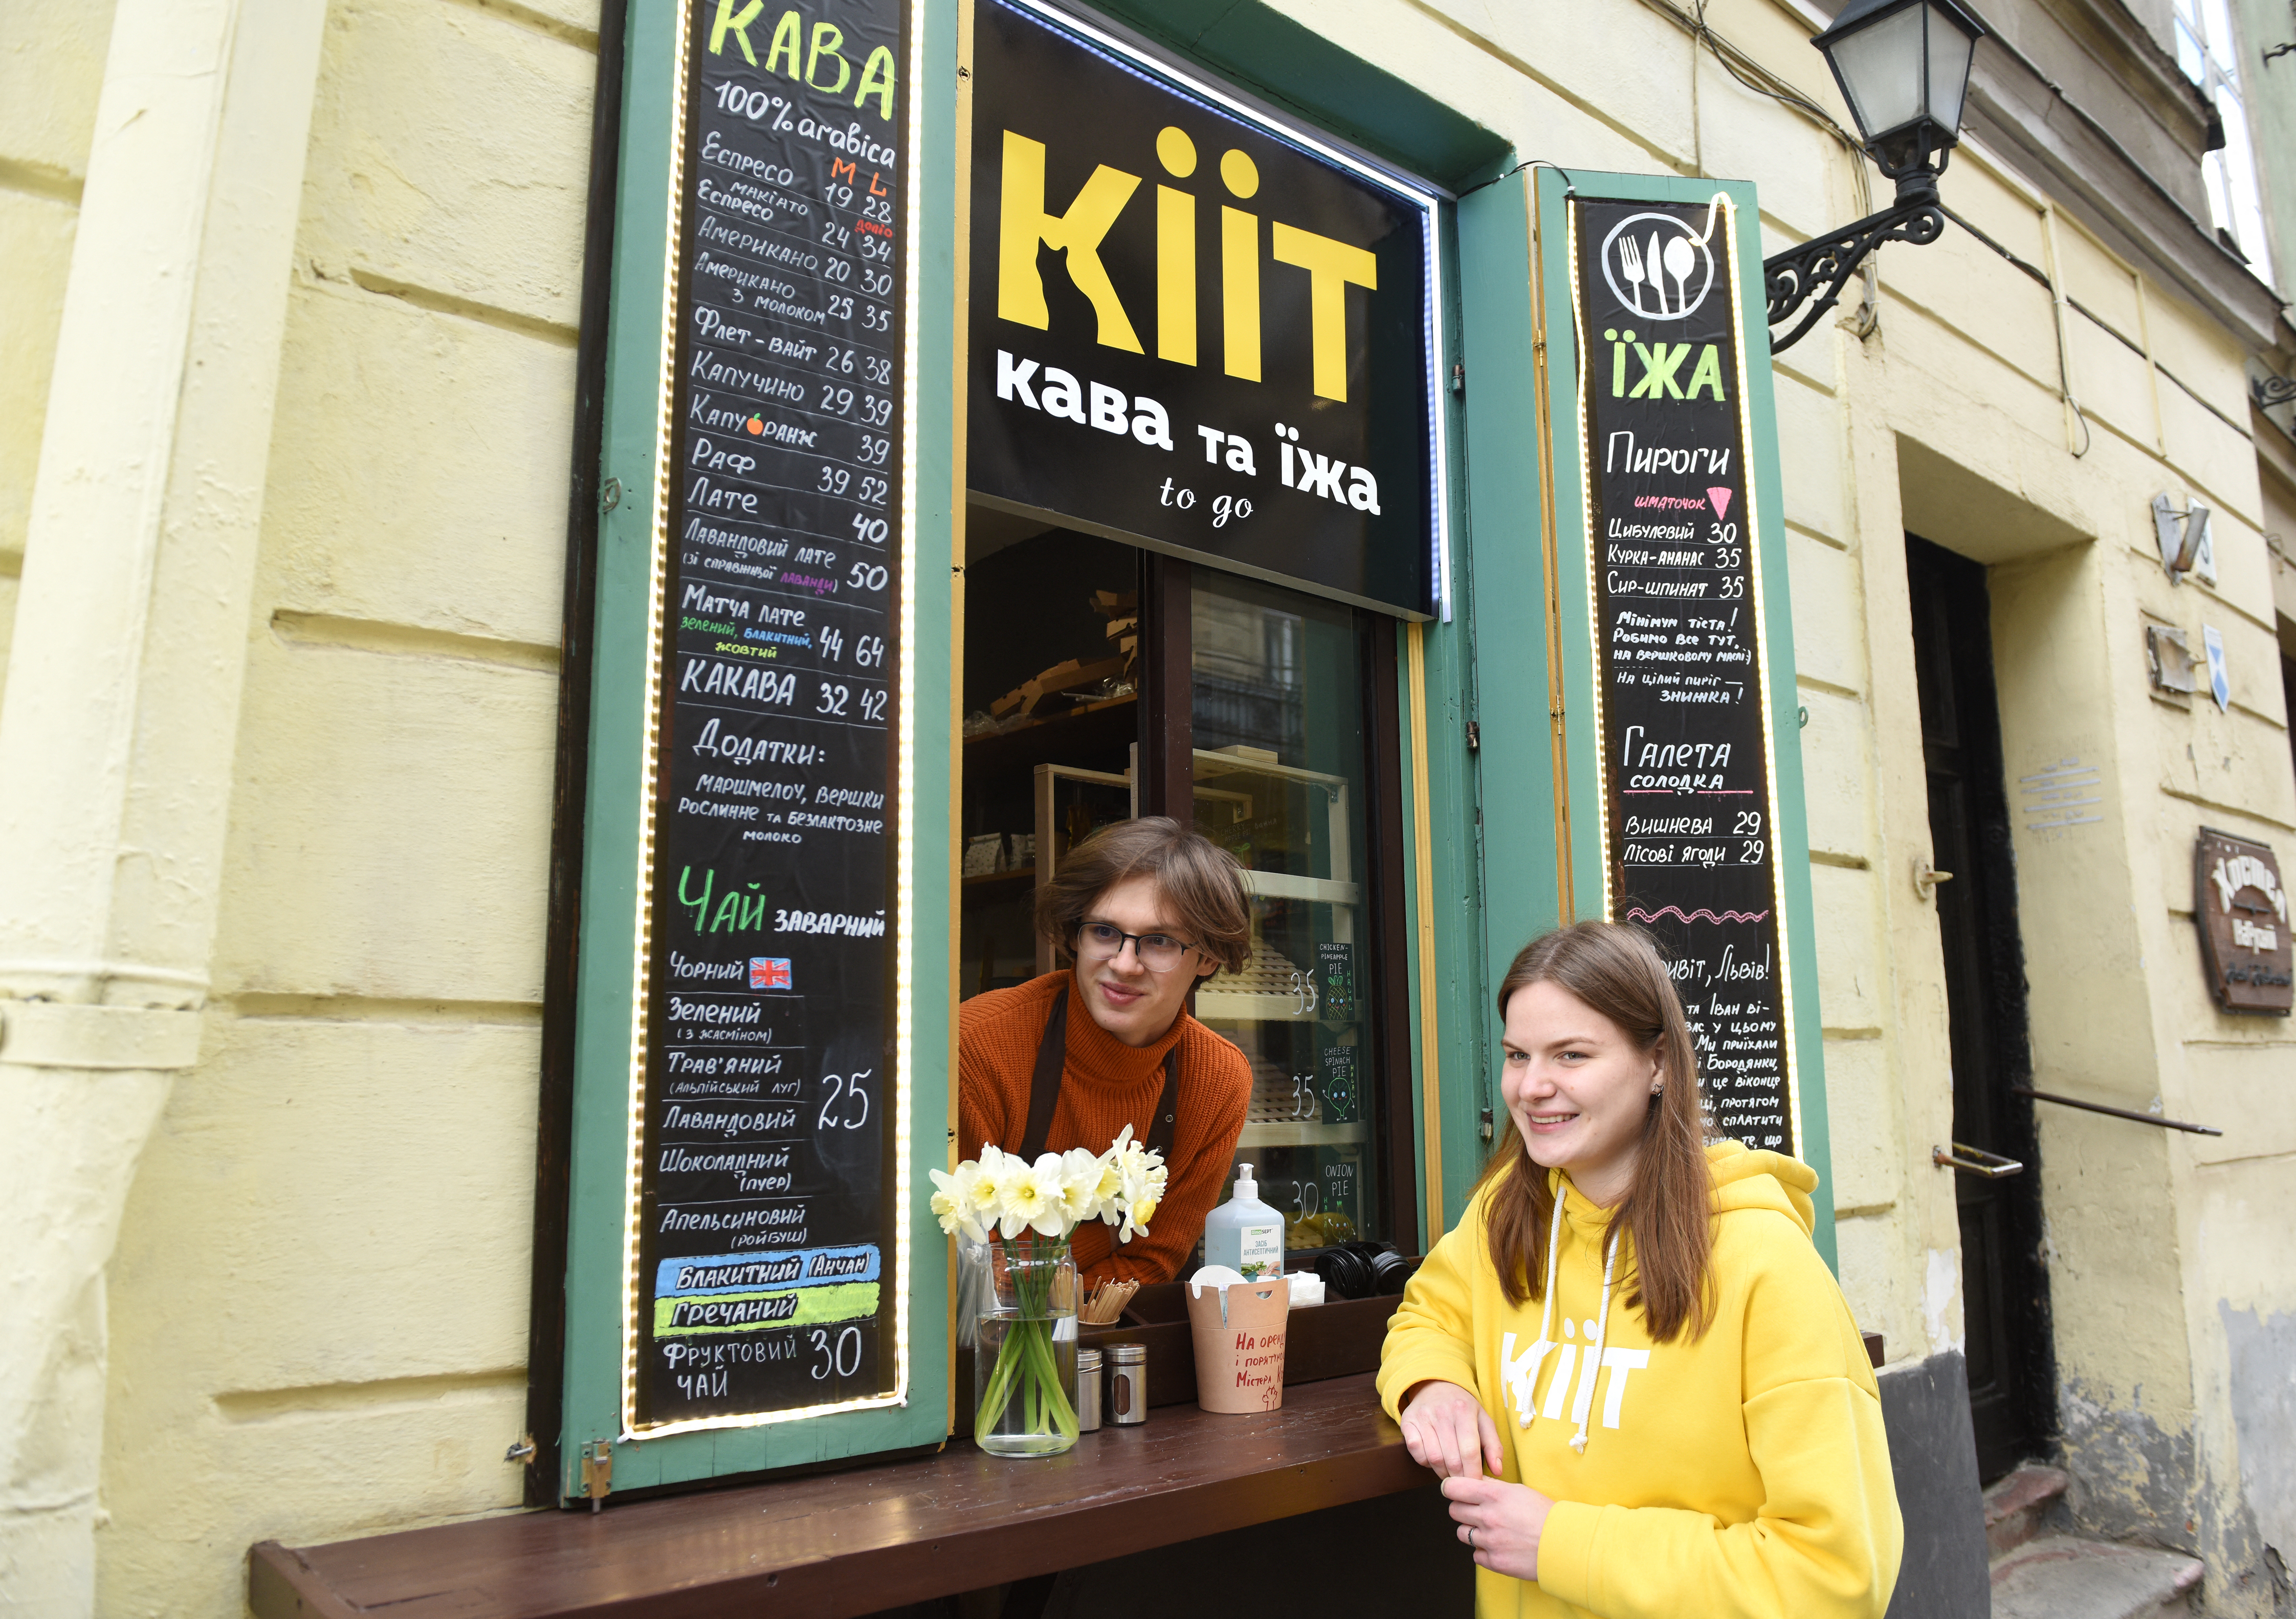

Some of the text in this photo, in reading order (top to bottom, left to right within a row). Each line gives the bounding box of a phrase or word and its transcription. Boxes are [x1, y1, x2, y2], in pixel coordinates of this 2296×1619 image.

[708, 0, 895, 121] КАВА
[715, 80, 895, 169] 100% arabica
[825, 182, 853, 207] 19
[863, 195, 892, 224] 28
[870, 172, 887, 197] L
[822, 222, 850, 249] 24
[862, 235, 891, 262] 34
[825, 257, 850, 282] 20
[860, 269, 892, 295] 30
[827, 295, 854, 320] 25
[862, 305, 892, 332] 35
[826, 346, 854, 374] 26
[865, 356, 892, 385] 38
[1604, 328, 1727, 402] ЇЖА
[821, 385, 853, 415] 29
[860, 395, 893, 426] 39
[857, 434, 890, 465] 39
[997, 348, 1381, 516] кава та їжа
[1606, 431, 1730, 475] Пироги
[817, 466, 850, 494] 39
[858, 476, 888, 505] 52
[1160, 476, 1254, 529] to go
[852, 513, 888, 543] 40
[1707, 522, 1737, 544] 30
[846, 562, 888, 591] 50
[1715, 548, 1742, 569] 35
[1719, 576, 1745, 599] 35
[819, 626, 844, 662] 44
[856, 635, 884, 668] 64
[816, 683, 849, 716] 32
[859, 689, 888, 721] 42
[1733, 811, 1761, 836] 29
[1739, 840, 1764, 864] 29
[1329, 962, 1342, 974] PIE
[1291, 969, 1316, 1015] 35
[1324, 1046, 1351, 1056] CHEESE
[1325, 1056, 1351, 1066] SPINACH
[1332, 1066, 1346, 1078] PIE
[818, 1068, 872, 1130] 25
[1292, 1075, 1315, 1118] 35
[1326, 1164, 1354, 1177] ONION
[1332, 1180, 1349, 1196] PIE
[1292, 1180, 1318, 1224] 30
[1243, 1246, 1278, 1256] АНТИСЕПТИЧНИЙ
[810, 1326, 862, 1380] 30
